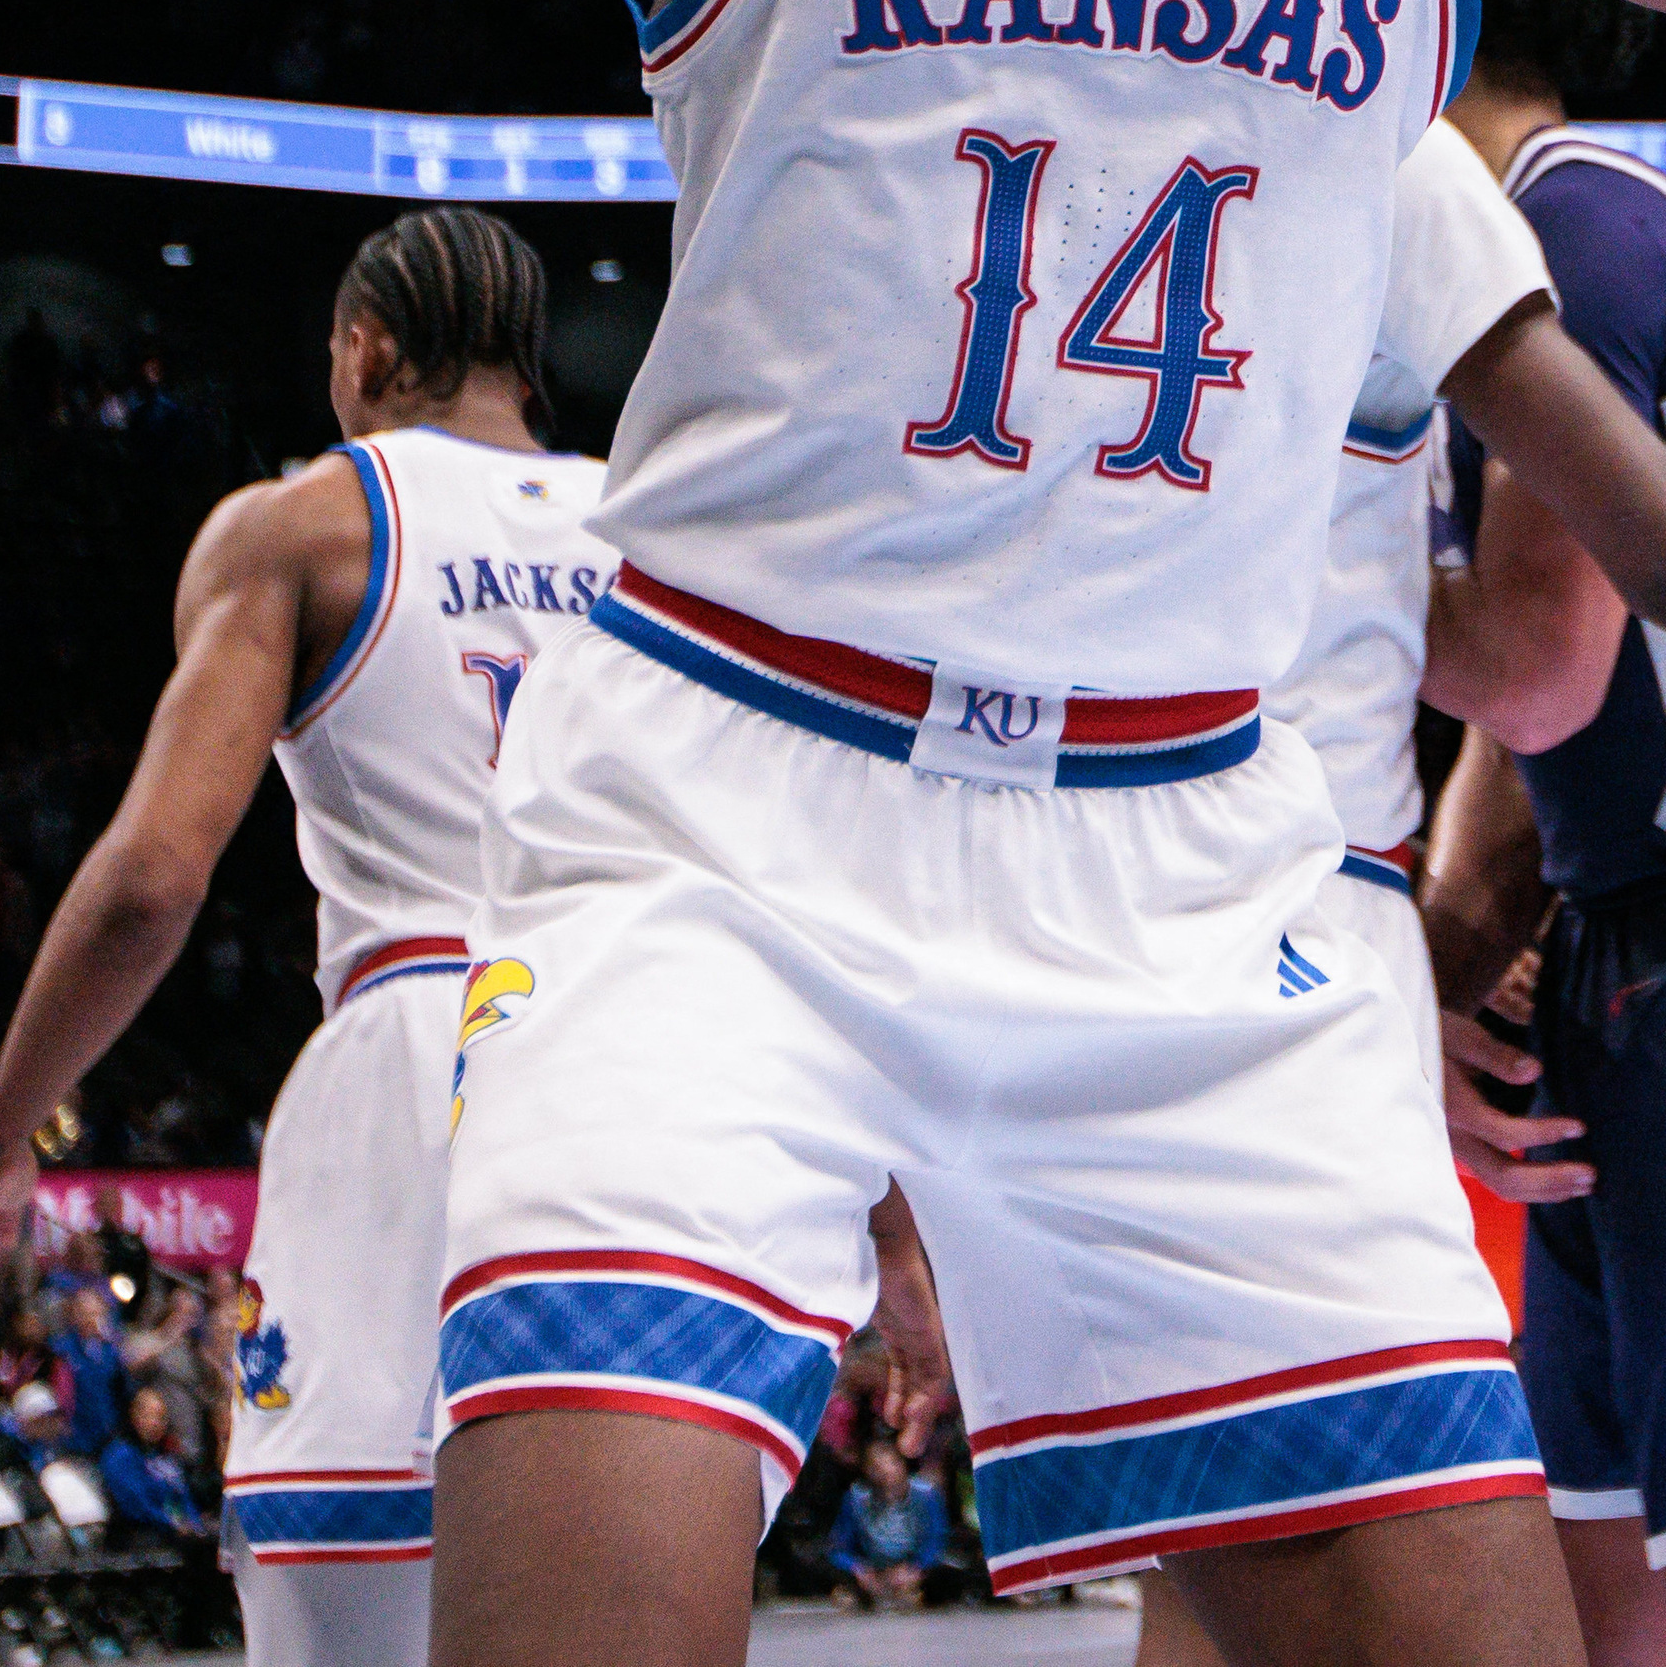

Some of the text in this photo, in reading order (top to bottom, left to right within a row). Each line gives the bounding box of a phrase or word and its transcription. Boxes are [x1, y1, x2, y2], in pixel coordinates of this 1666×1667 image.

[184, 116, 276, 164] White
[901, 128, 1261, 493] 14
[437, 555, 619, 618] JACKS
[954, 685, 1042, 748] KU
[33, 1185, 235, 1256] Mbile
